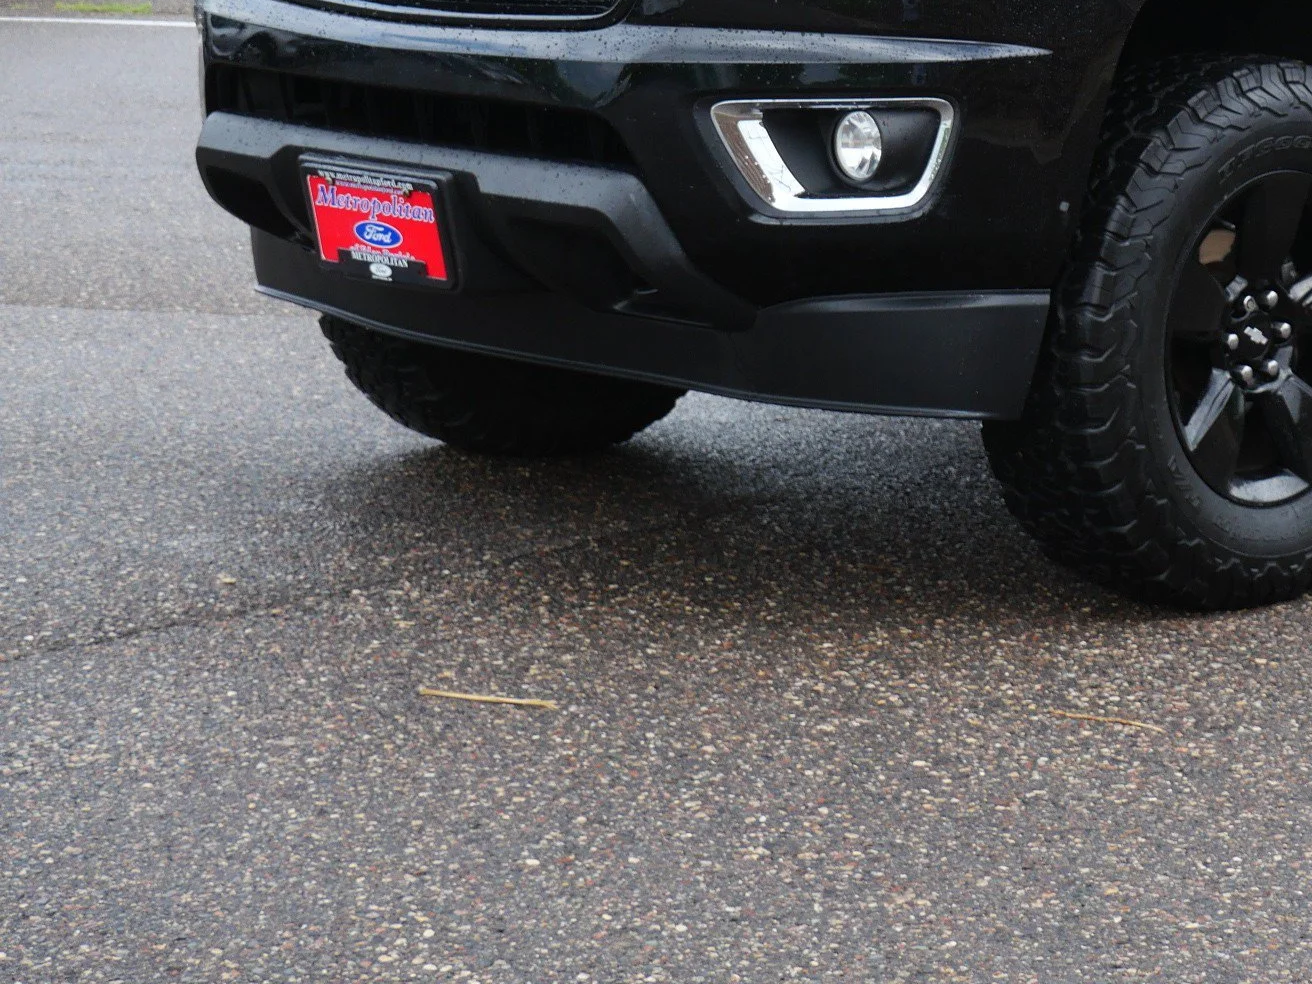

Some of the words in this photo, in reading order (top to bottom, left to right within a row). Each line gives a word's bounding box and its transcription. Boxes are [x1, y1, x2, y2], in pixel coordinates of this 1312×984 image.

[316, 184, 435, 222] Metropolitan
[363, 223, 392, 243] Ford
[351, 250, 408, 268] METROPOLITAN
